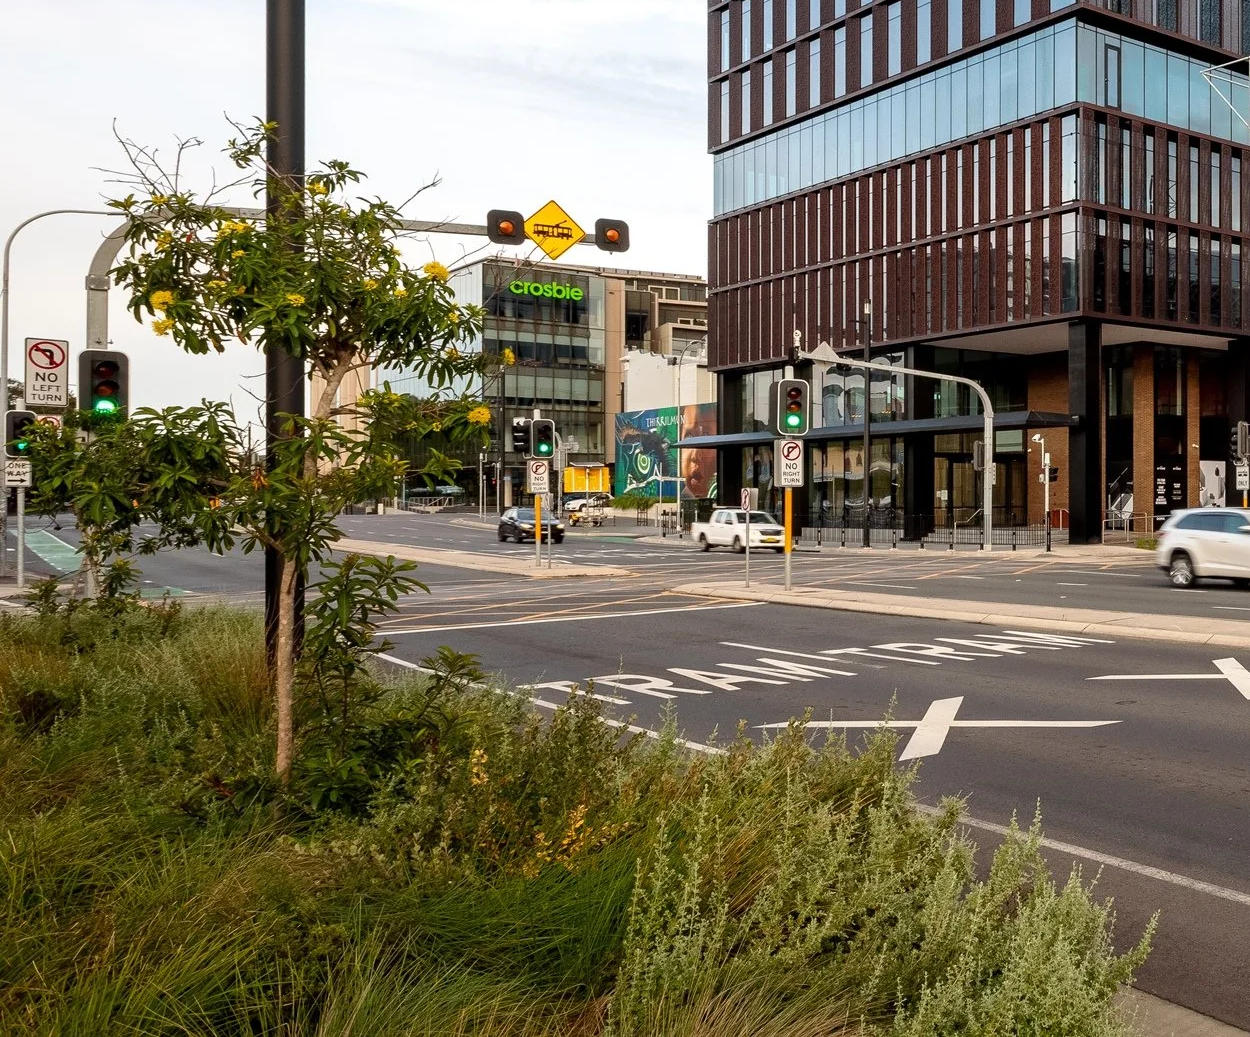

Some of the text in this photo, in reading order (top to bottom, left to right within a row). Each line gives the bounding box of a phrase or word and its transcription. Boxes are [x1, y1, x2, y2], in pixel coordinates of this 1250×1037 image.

[509, 280, 584, 301] crosbie
[35, 372, 58, 383] NO
[32, 384, 61, 392] LEFT
[31, 394, 62, 402] TURN
[785, 462, 798, 470] NO
[817, 630, 1116, 665] TRAM
[515, 657, 859, 705] TRAM
